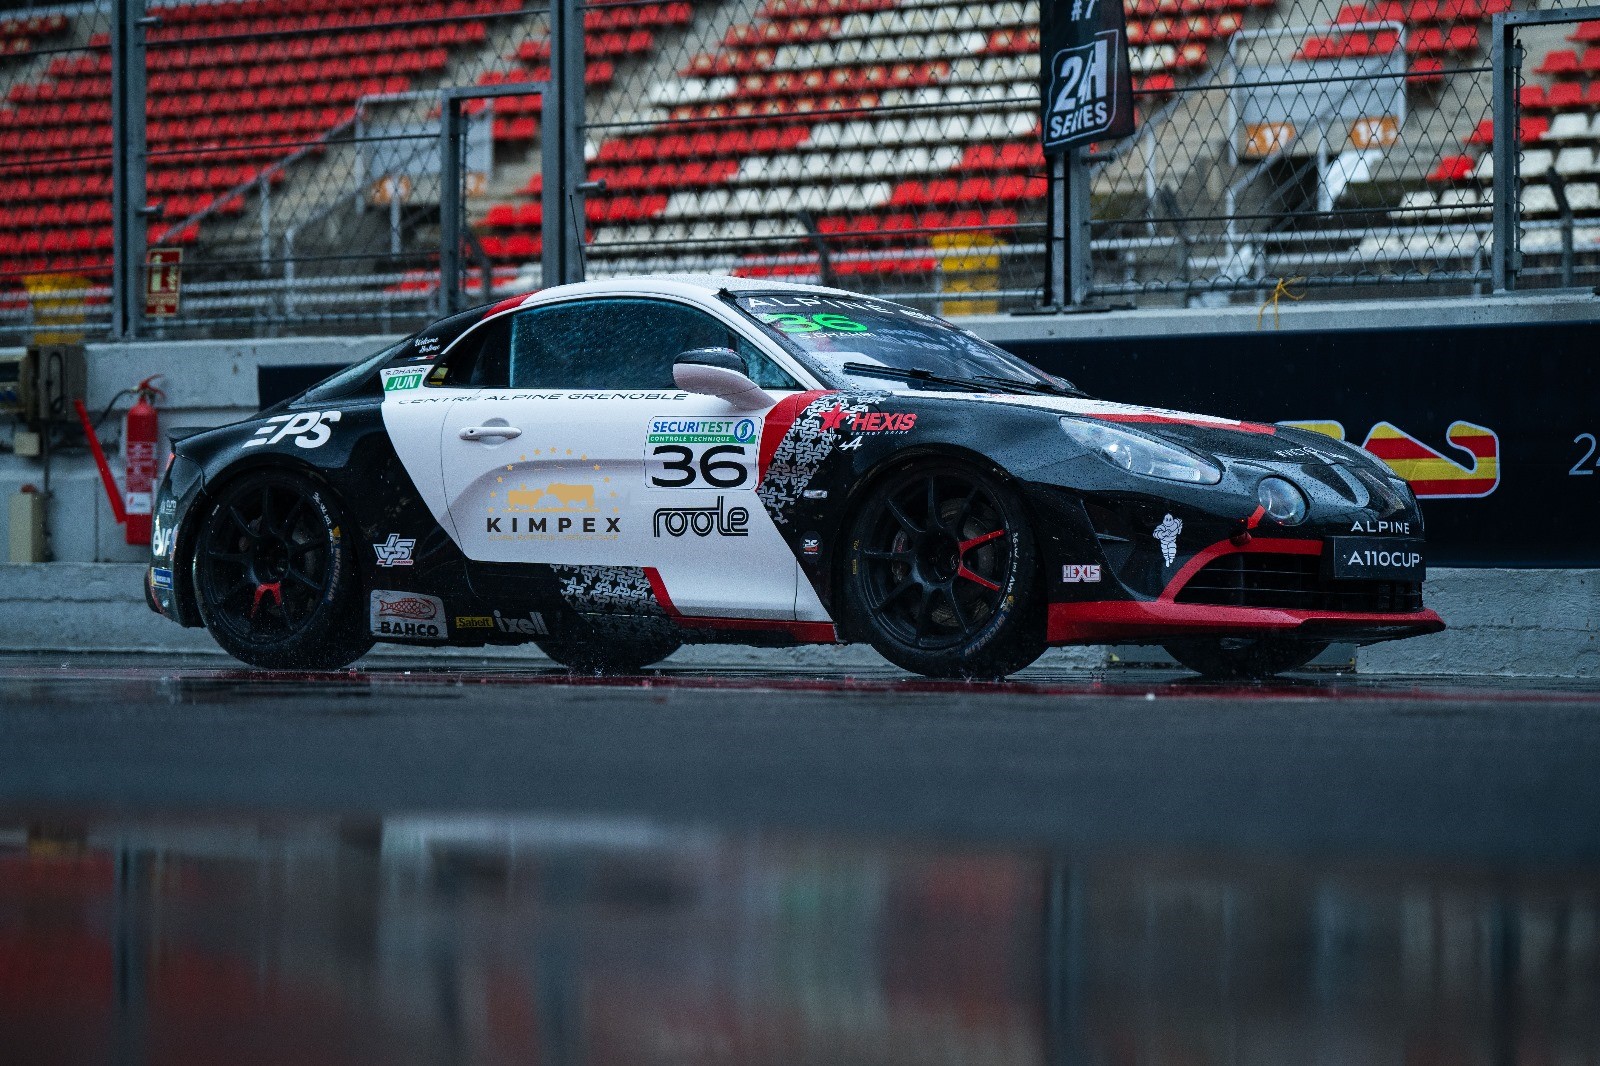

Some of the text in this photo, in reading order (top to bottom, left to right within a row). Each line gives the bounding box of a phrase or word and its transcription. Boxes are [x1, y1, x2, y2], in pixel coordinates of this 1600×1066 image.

[760, 313, 868, 333] 36
[389, 376, 418, 390] JUN
[484, 393, 563, 401] ALPINE
[567, 393, 689, 401] GRENOBLE
[241, 410, 342, 449] EPS
[652, 421, 734, 433] SECURITEST
[851, 411, 918, 431] HEXIS
[1569, 433, 1600, 475] 2
[651, 445, 748, 488] 36
[486, 517, 620, 532] KIMPEX
[1350, 520, 1410, 534] ALPINE
[1347, 550, 1420, 567] A110CUP
[1061, 564, 1101, 582] HEXIS
[380, 621, 440, 637] BAHCO
[457, 616, 493, 629] Sabelt
[493, 609, 550, 635] ixell
